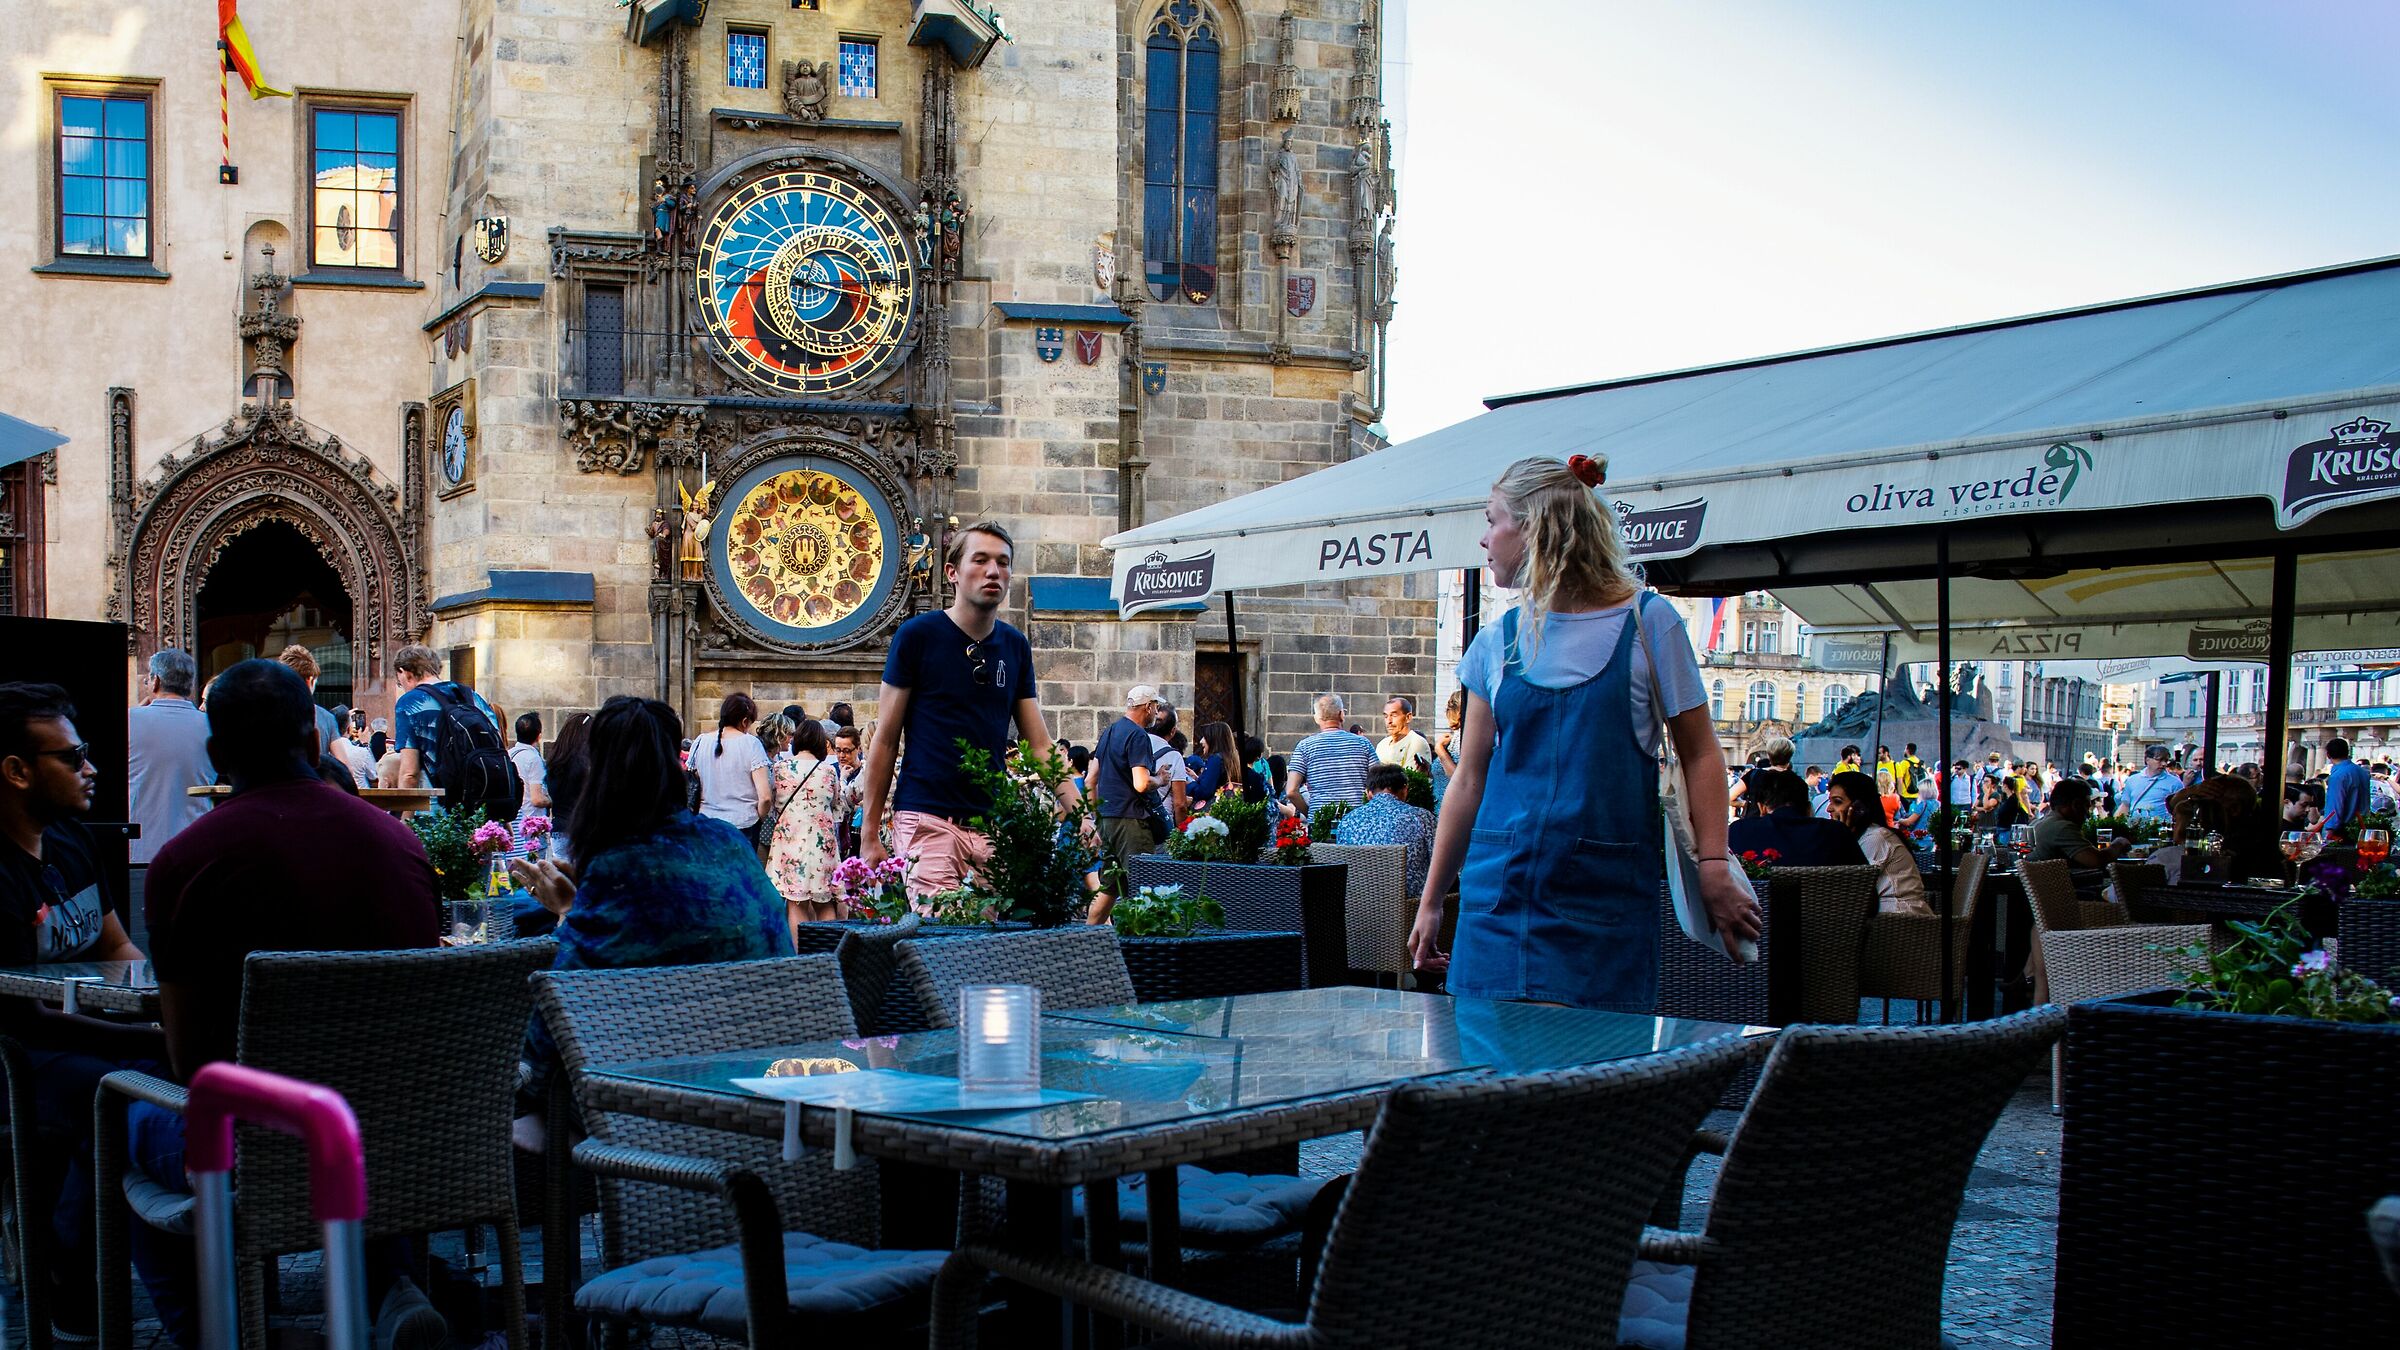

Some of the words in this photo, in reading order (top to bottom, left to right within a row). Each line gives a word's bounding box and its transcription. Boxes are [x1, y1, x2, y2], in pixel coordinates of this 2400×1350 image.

[1846, 483, 1935, 513] oliva
[1943, 498, 2056, 517] ristorante
[1319, 529, 1433, 570] PASTA
[1133, 569, 1204, 595] KRUŠOVICE
[2322, 650, 2362, 661] TORO
[2366, 649, 2400, 660] NEG
